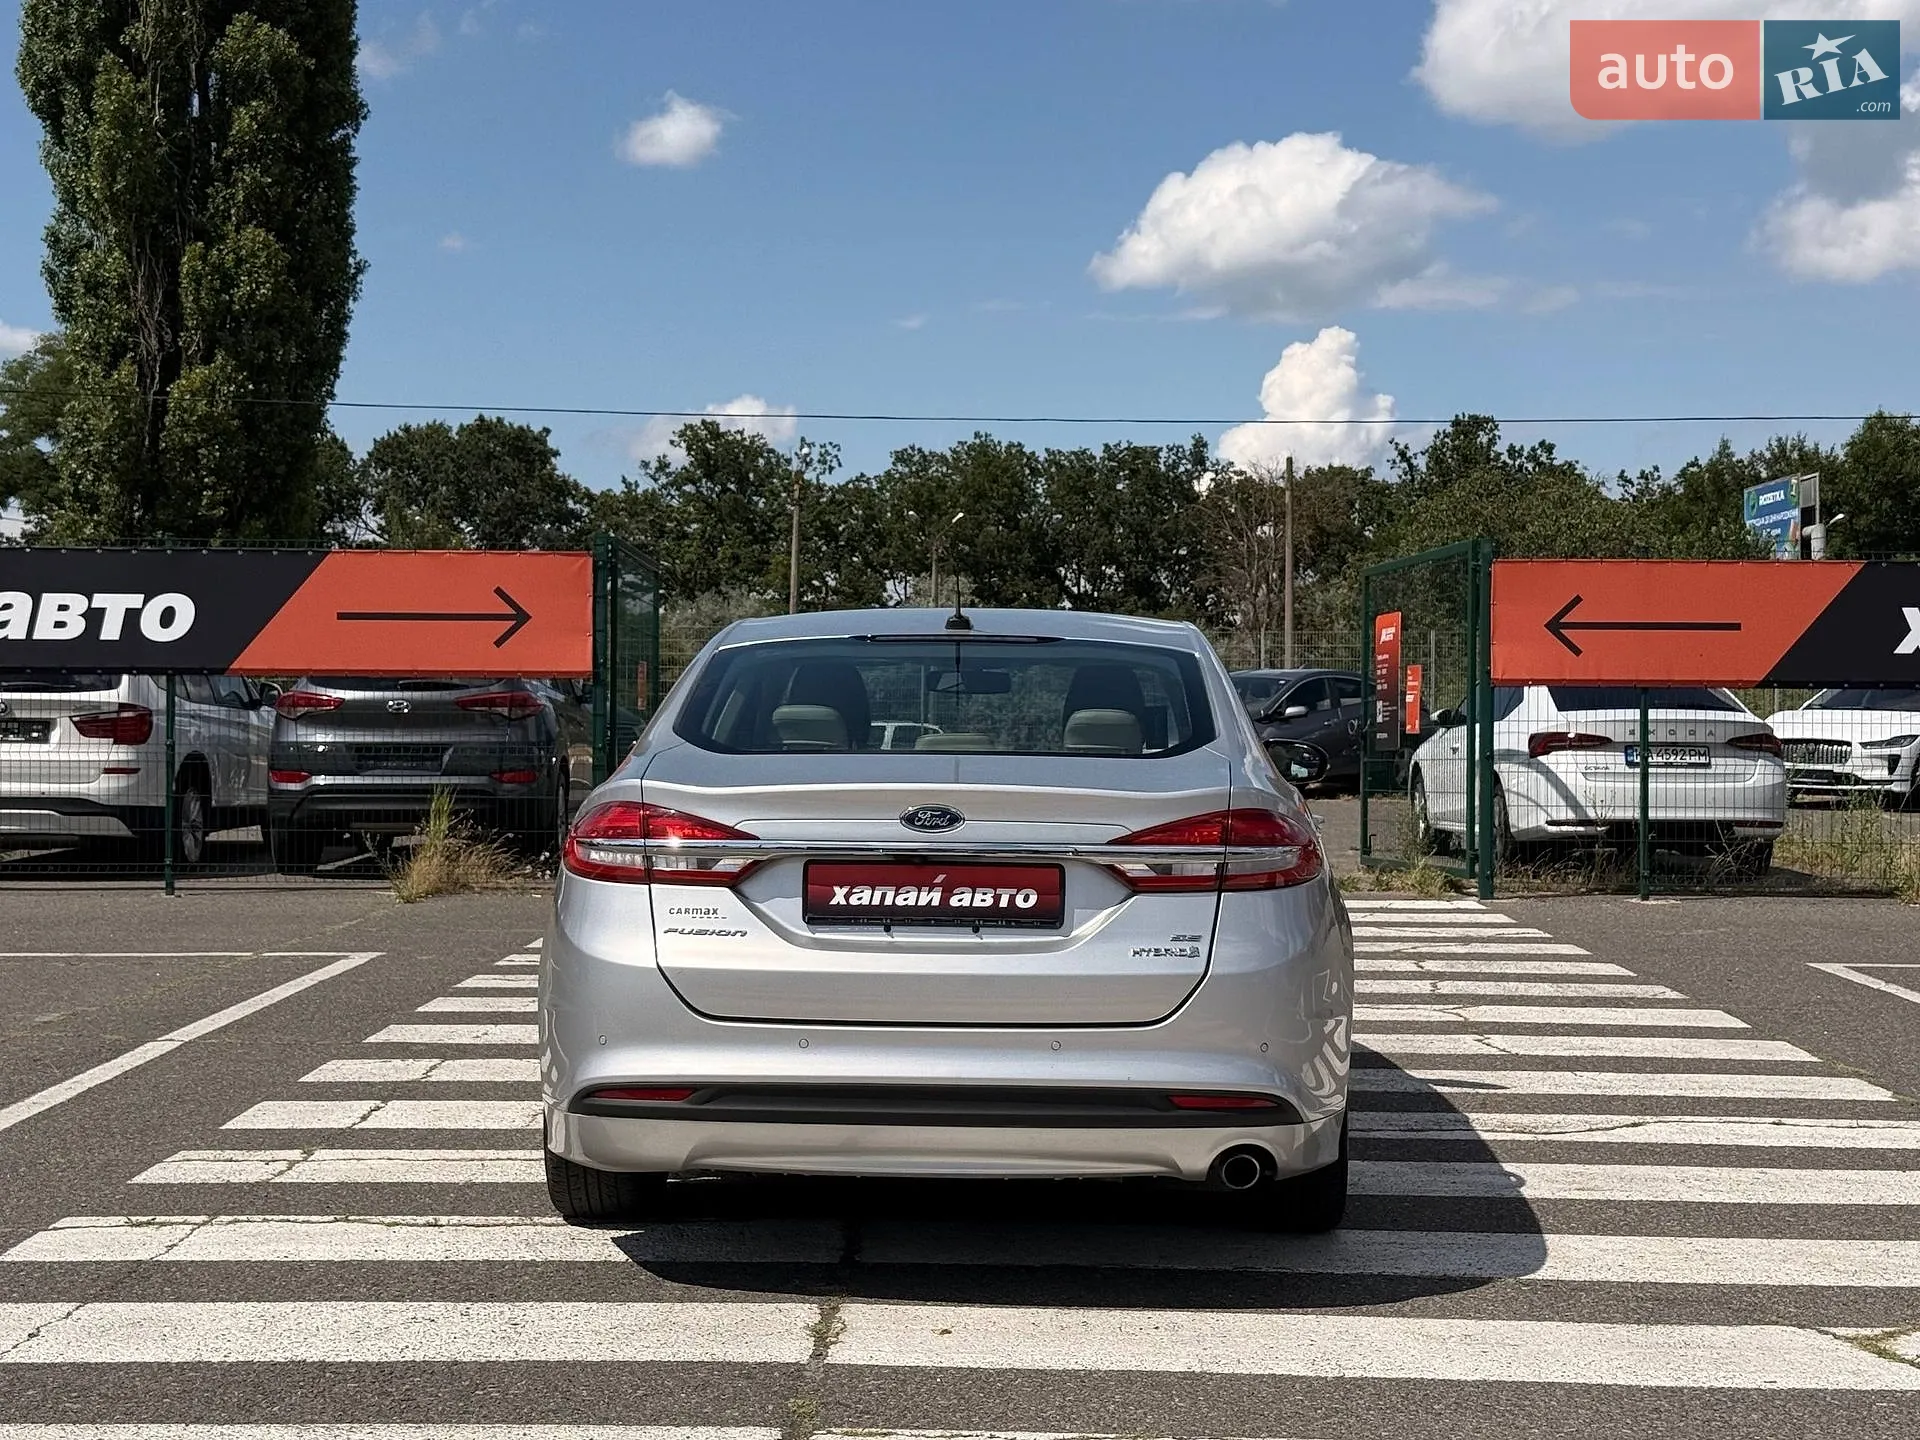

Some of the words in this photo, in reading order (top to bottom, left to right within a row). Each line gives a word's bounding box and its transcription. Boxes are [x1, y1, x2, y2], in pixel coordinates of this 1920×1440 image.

[1656, 748, 1687, 761] 4592
[915, 810, 951, 827] Ford
[829, 874, 947, 906] хапай
[950, 887, 1038, 909] авто
